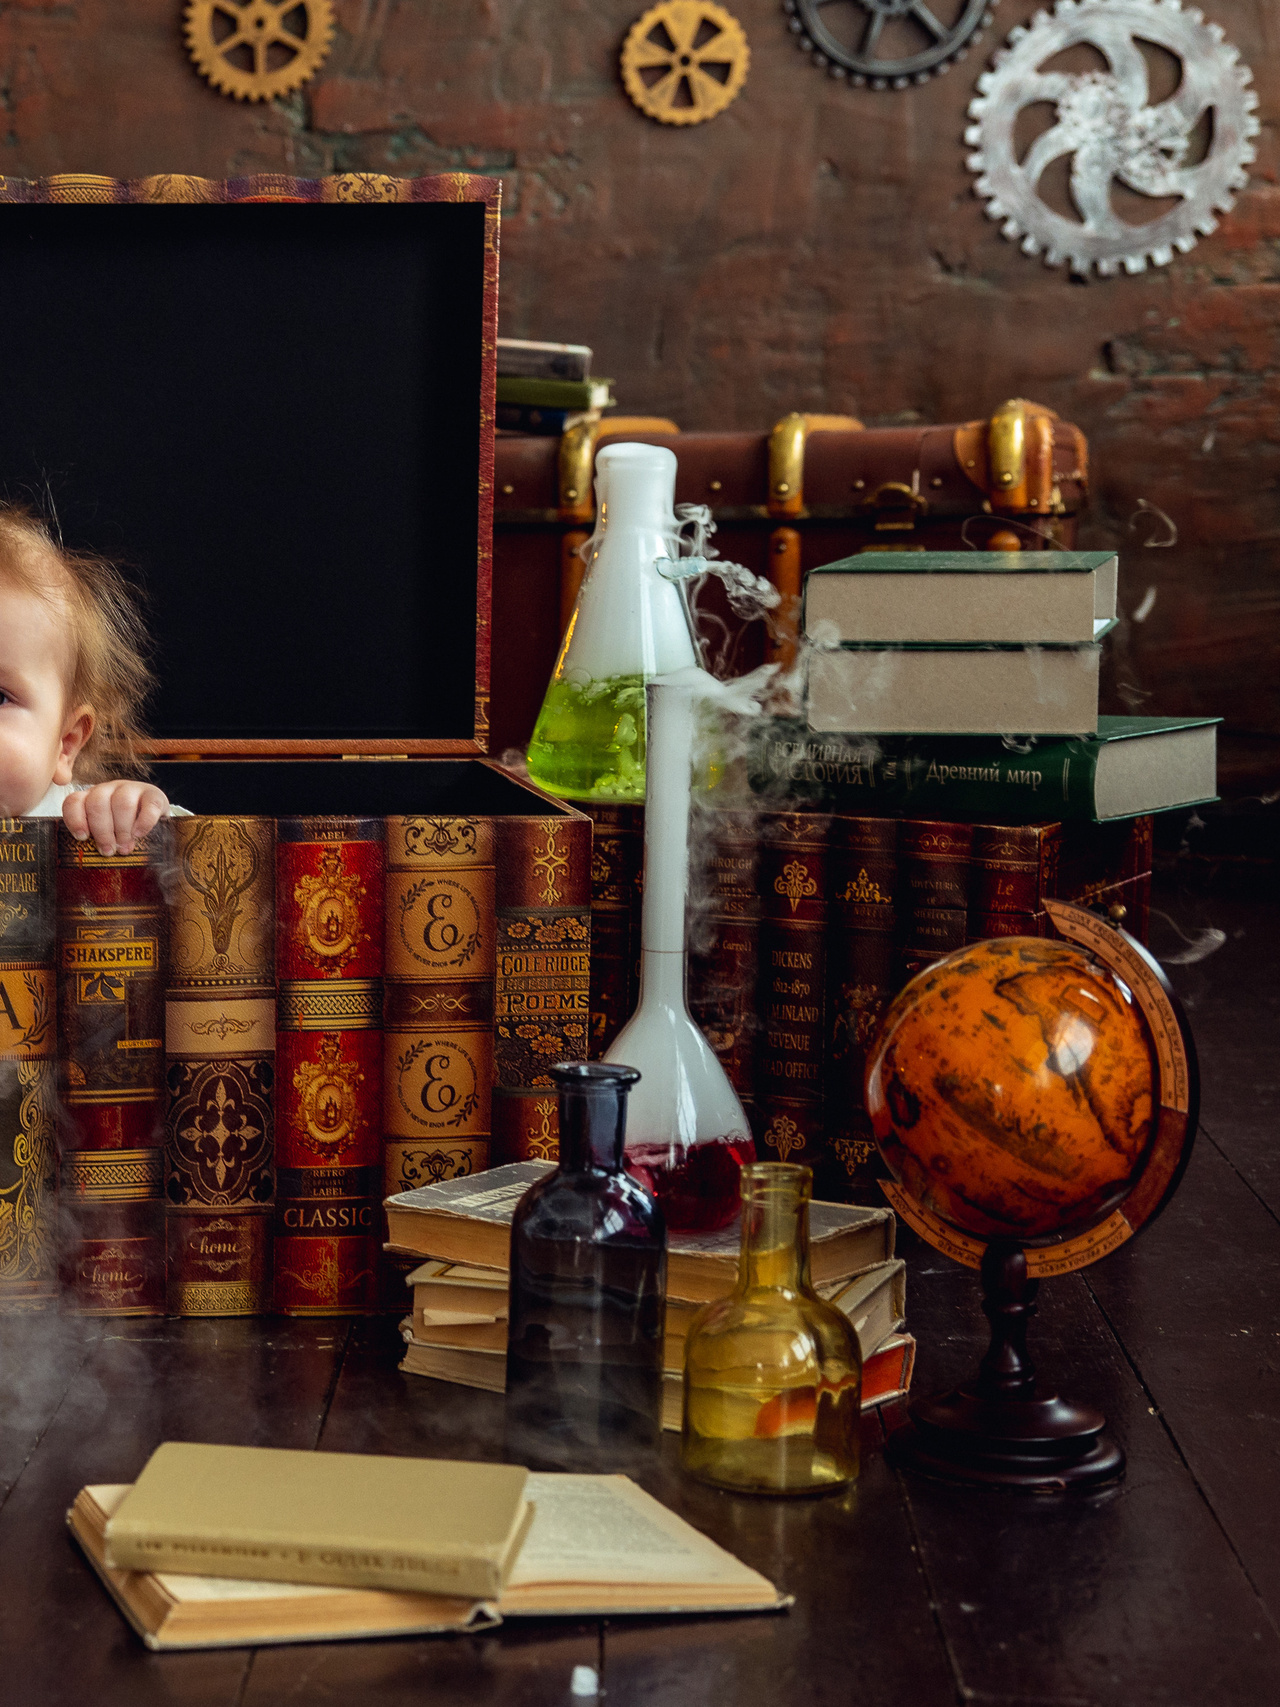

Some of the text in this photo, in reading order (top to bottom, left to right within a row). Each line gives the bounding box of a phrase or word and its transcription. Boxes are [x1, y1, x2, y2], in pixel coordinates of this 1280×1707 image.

[926, 759, 1043, 791] Древний мир
[314, 831, 346, 840] LABEL
[706, 857, 752, 869] THROUGH
[717, 872, 738, 884] THE
[997, 879, 1015, 896] Le
[986, 919, 1022, 934] Prince
[722, 939, 752, 952] Carroll
[65, 946, 152, 963] SHAKSPERE
[771, 950, 813, 970] DICKENS
[773, 977, 811, 998] 1812-1870
[502, 993, 589, 1013] POEMS
[434, 1040, 458, 1050] WHERE
[768, 1030, 811, 1051] REVENUE
[785, 1061, 819, 1080] OFFICE
[313, 1169, 346, 1178] RETRO
[313, 1187, 346, 1196] LABEL
[283, 1206, 372, 1228] CLASSIC
[190, 1236, 251, 1255] home
[82, 1265, 143, 1283] home
